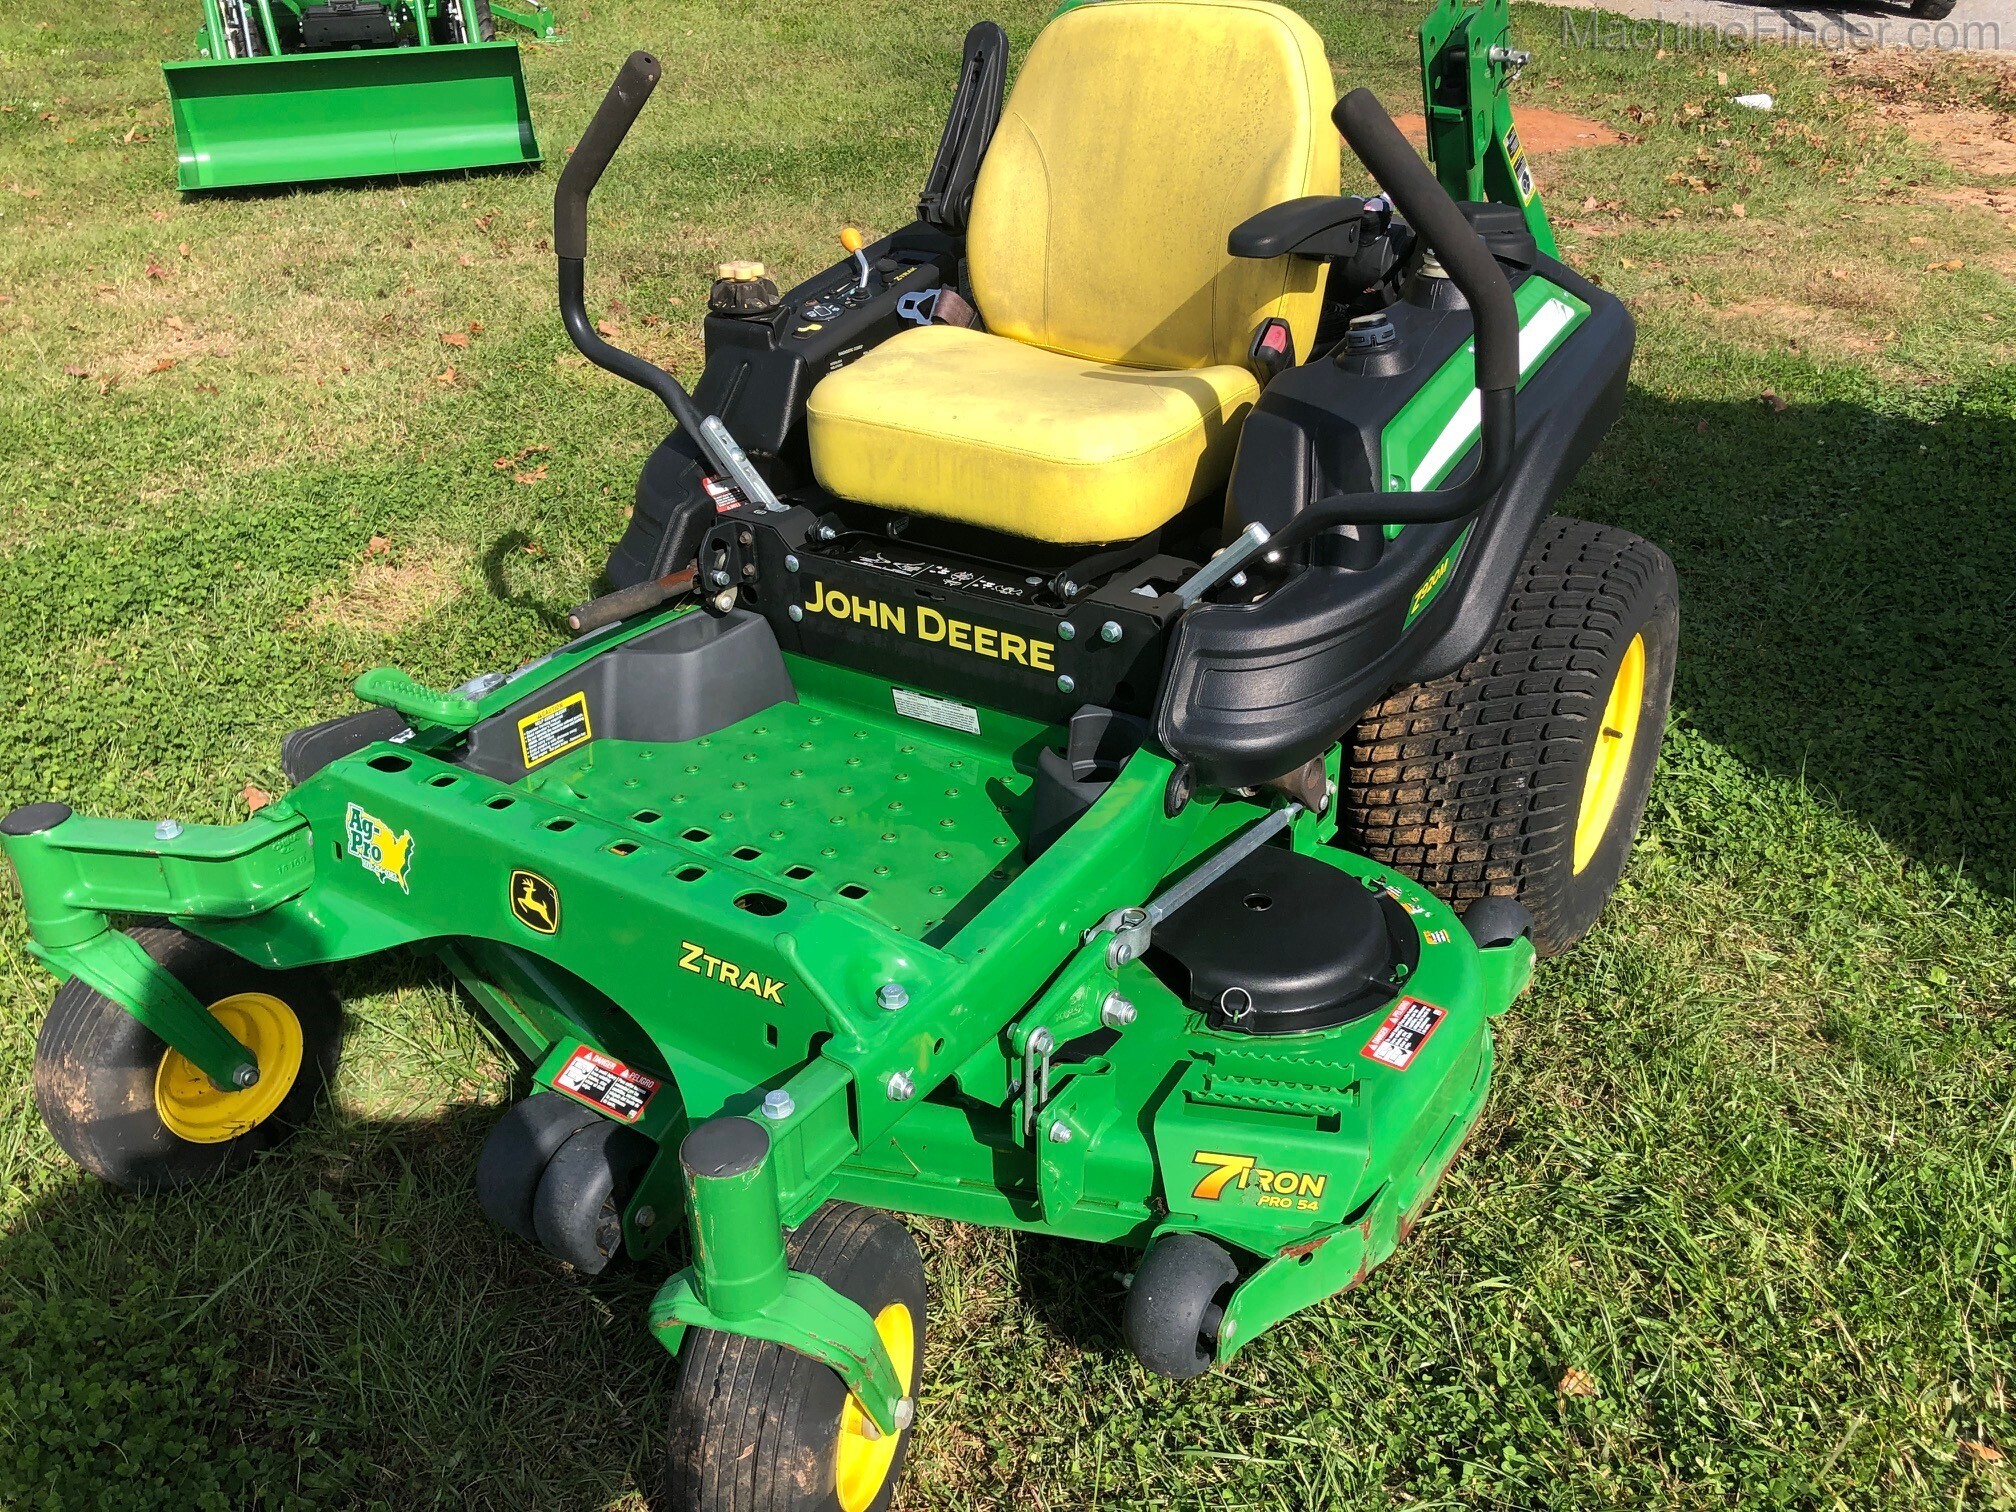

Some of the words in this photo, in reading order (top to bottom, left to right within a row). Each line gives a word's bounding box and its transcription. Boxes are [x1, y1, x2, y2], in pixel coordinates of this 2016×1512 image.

[1410, 558, 1449, 615] Z920M
[805, 581, 906, 635] JOHN
[917, 605, 1055, 672] DEERE
[349, 808, 380, 841] Ag-
[350, 830, 382, 862] Pro
[679, 940, 786, 1006] ZTRAK
[592, 1054, 617, 1071] DANGER
[629, 1072, 655, 1089] PELIGRO
[1256, 1195, 1292, 1208] PRO
[1296, 1199, 1319, 1211] 54
